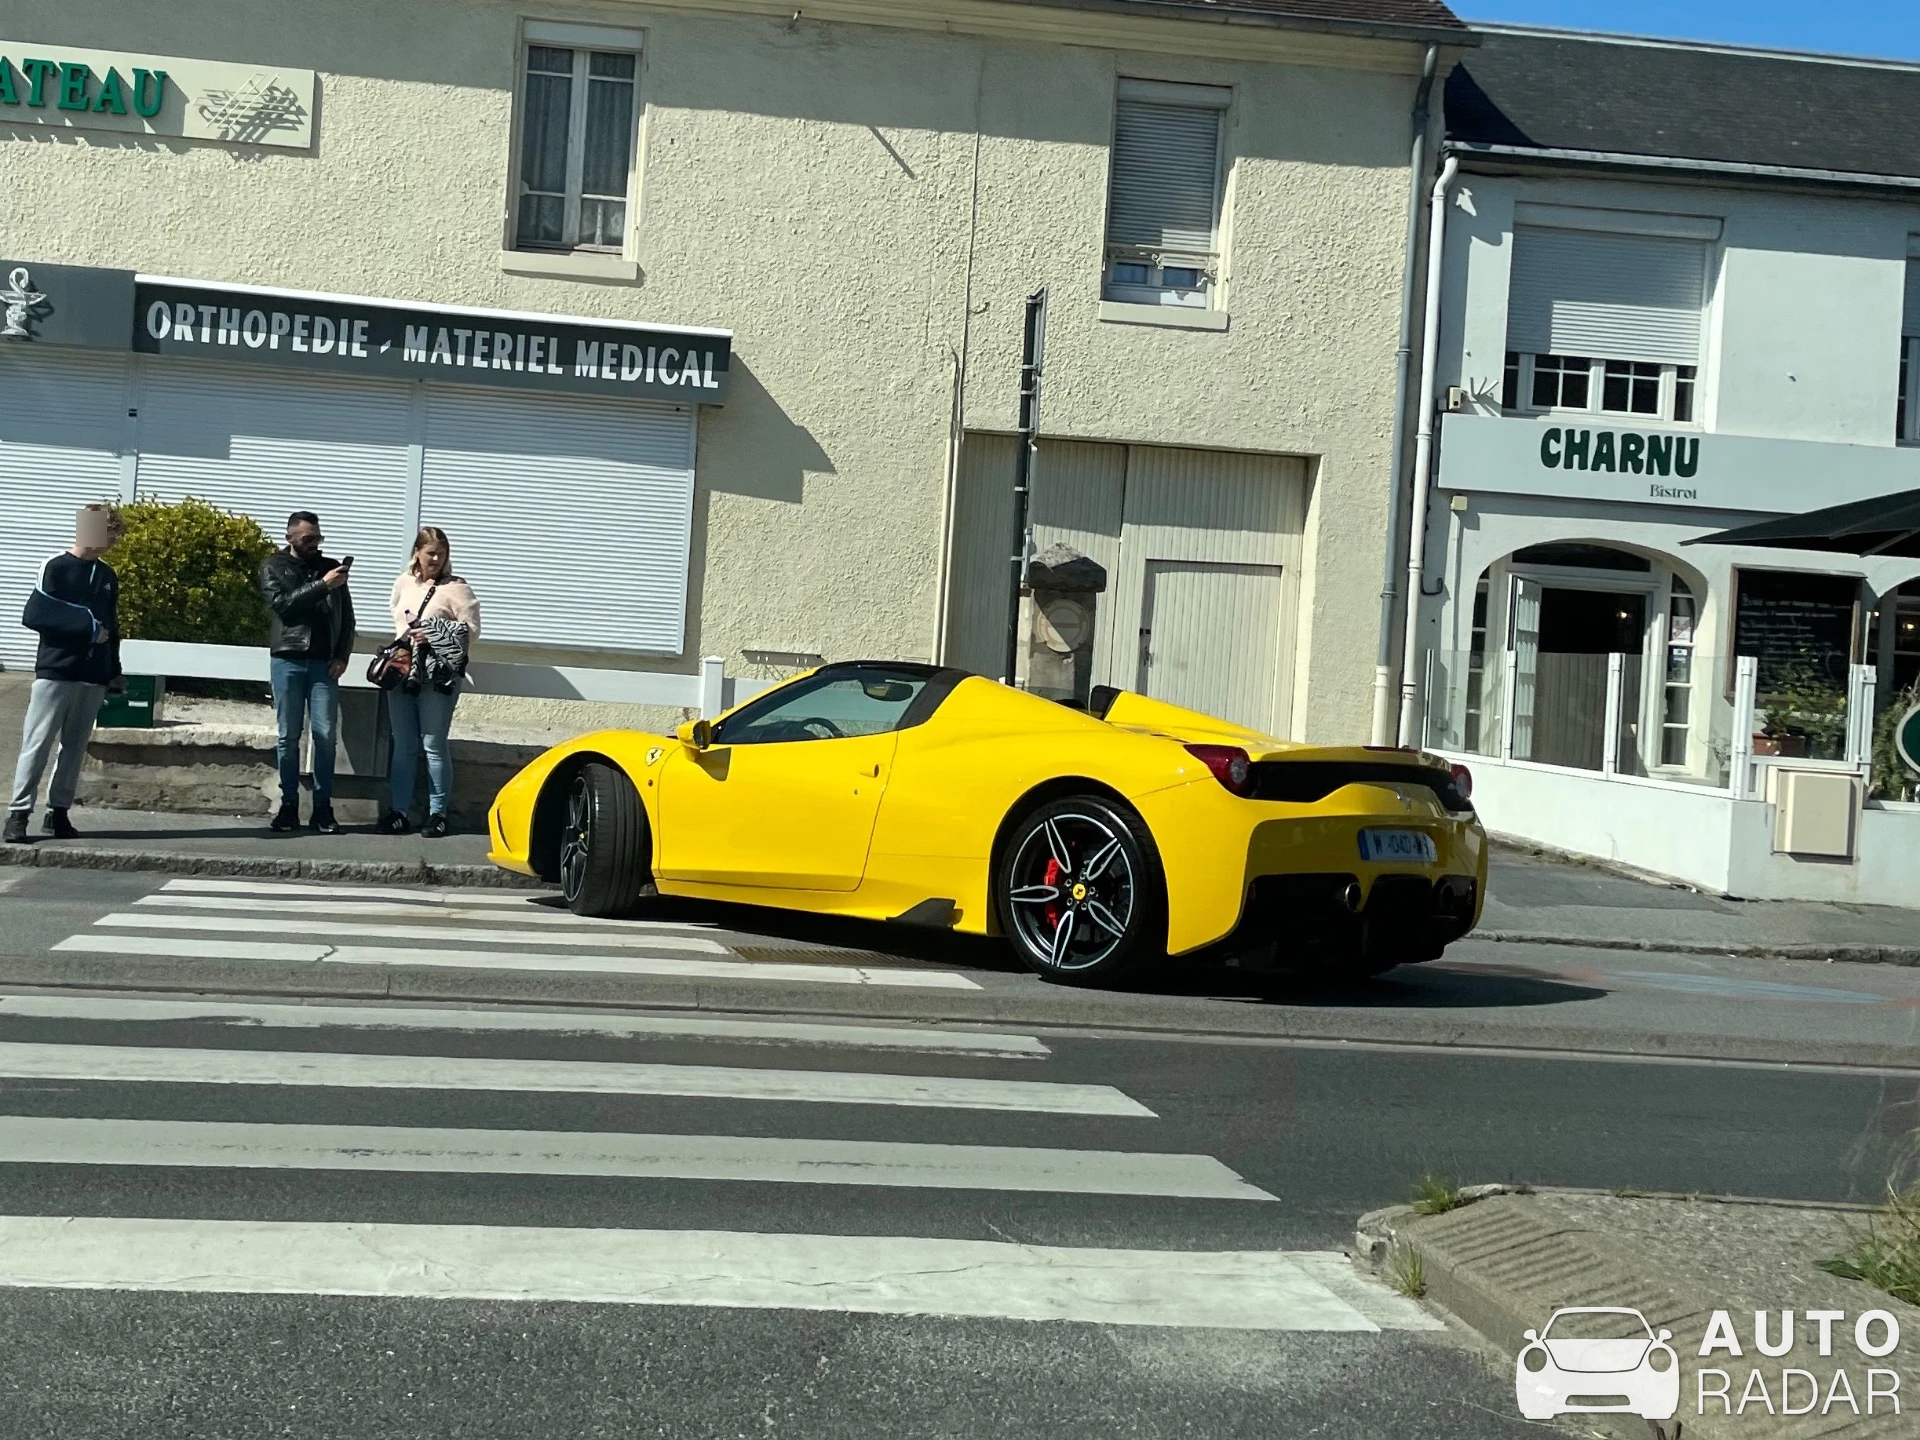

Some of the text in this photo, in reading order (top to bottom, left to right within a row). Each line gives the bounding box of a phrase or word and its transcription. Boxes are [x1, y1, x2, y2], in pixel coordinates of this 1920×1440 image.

[146, 301, 370, 358] ORTHOPEDIE
[403, 324, 563, 375] MATERIEL
[575, 340, 719, 389] MEDICAL
[1540, 427, 1700, 478] CHARNU
[1649, 484, 1697, 500] Bistrot
